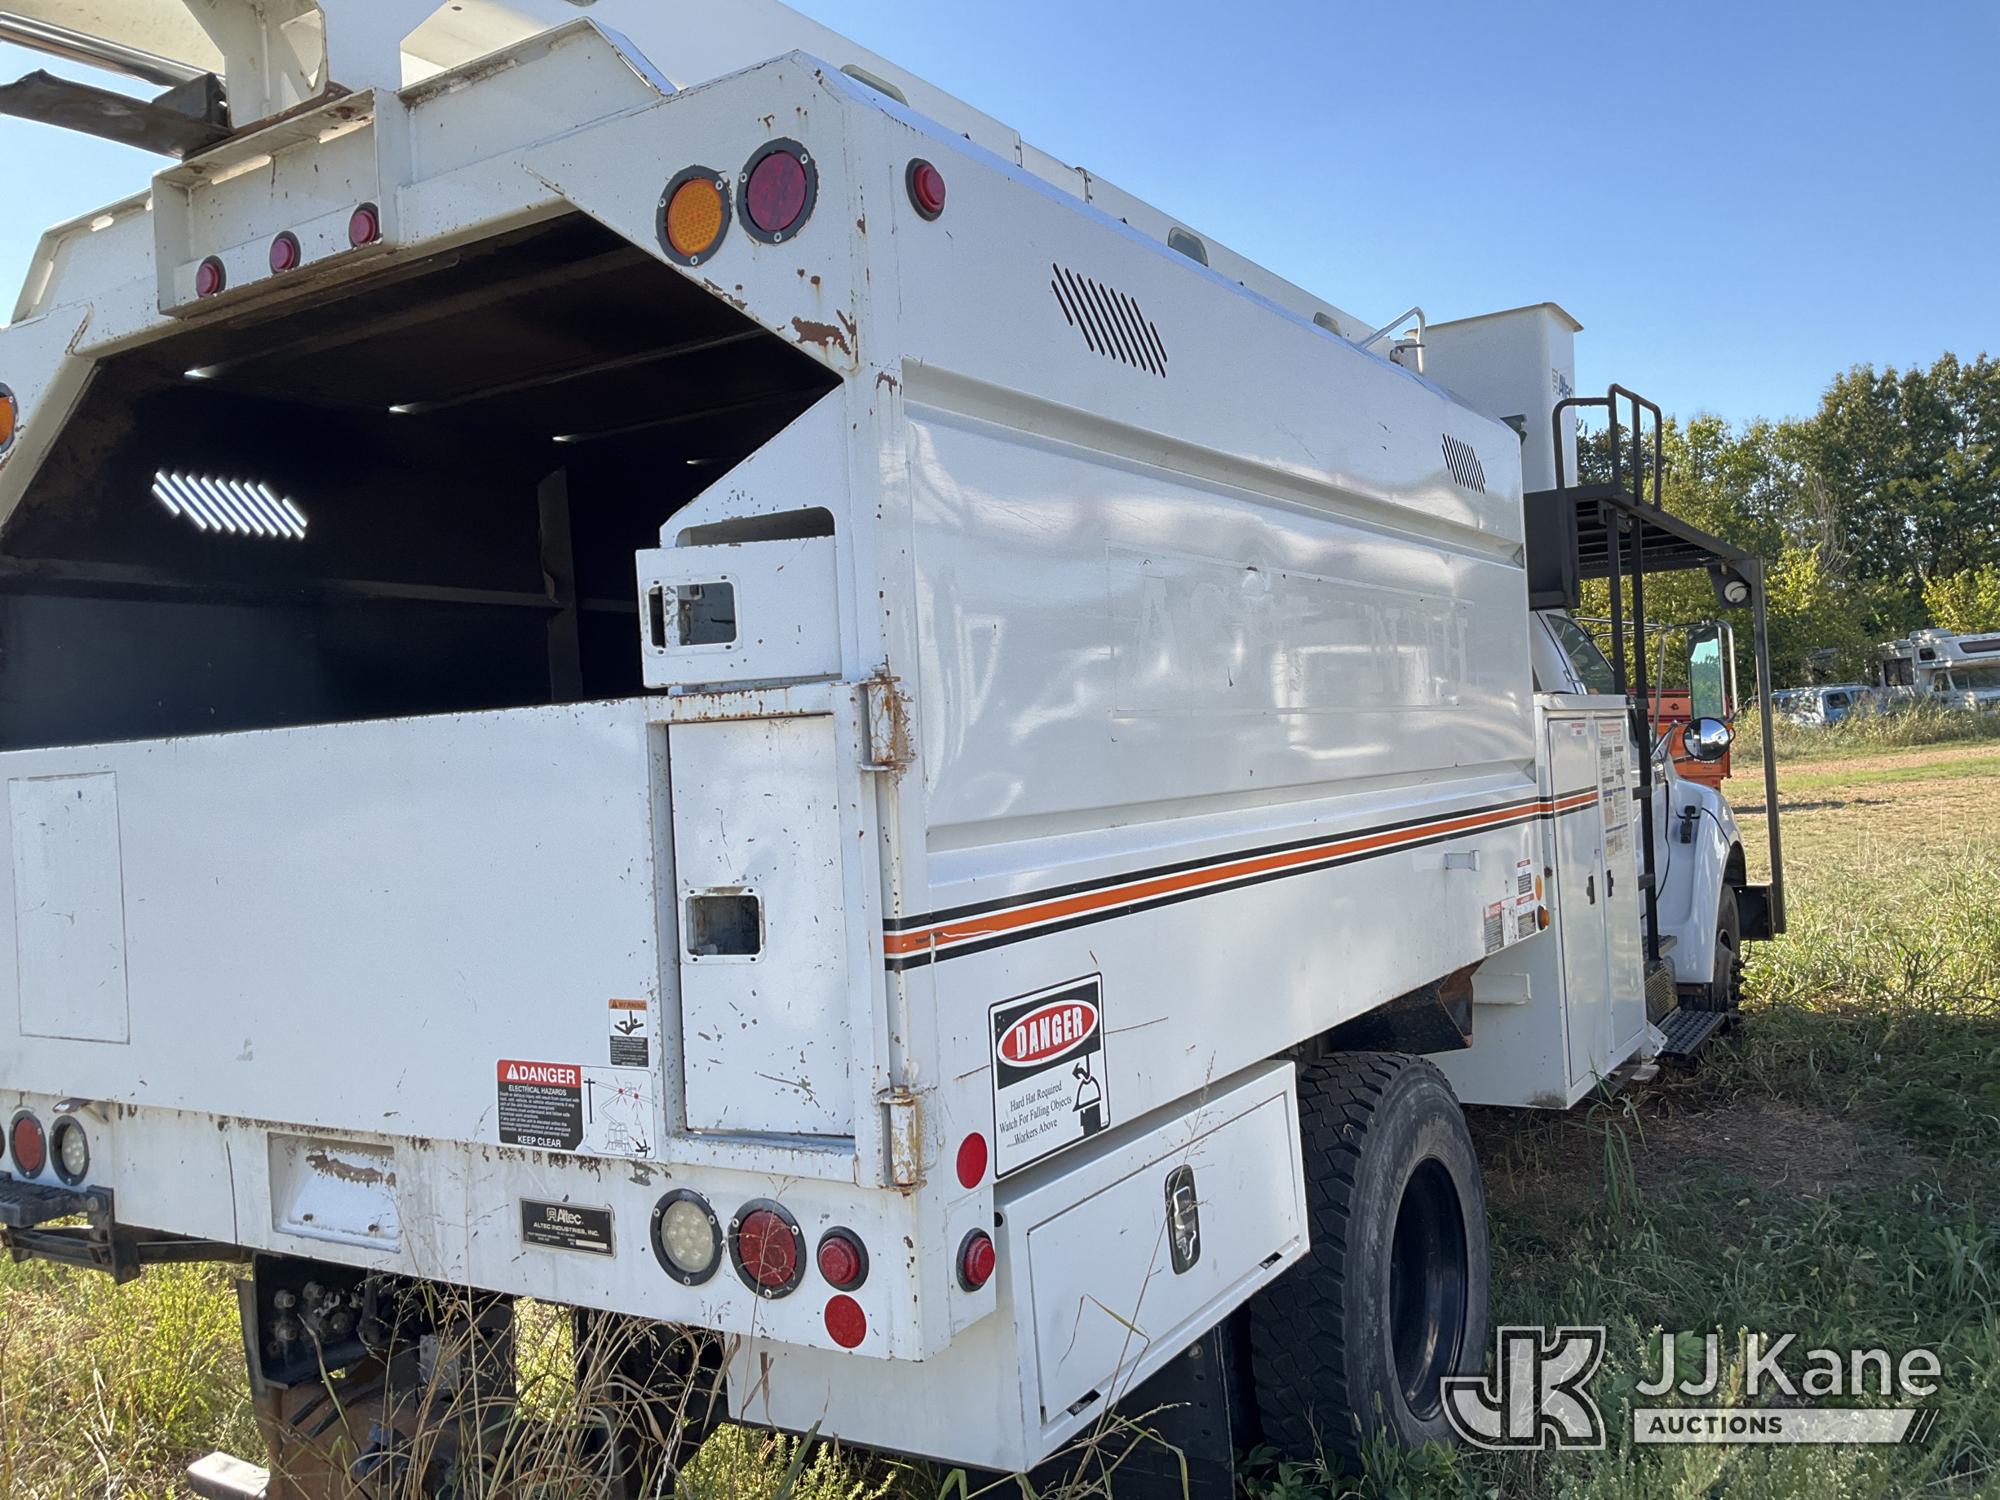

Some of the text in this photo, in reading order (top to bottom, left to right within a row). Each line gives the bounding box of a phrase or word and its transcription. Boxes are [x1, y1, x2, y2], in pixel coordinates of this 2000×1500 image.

[1015, 1006, 1083, 1059] DANGER
[519, 1066, 576, 1085] DANGER
[508, 1084, 567, 1096] ELECTRICAL HAZARDS
[1010, 1081, 1062, 1112] Hard Hat Required
[999, 1094, 1072, 1134] Watch For Falling Objects
[1014, 1118, 1058, 1145] Workers Above
[517, 1135, 562, 1148] KEEP CLEAR
[534, 1221, 550, 1230] ALTEC
[557, 1208, 581, 1224] Altec
